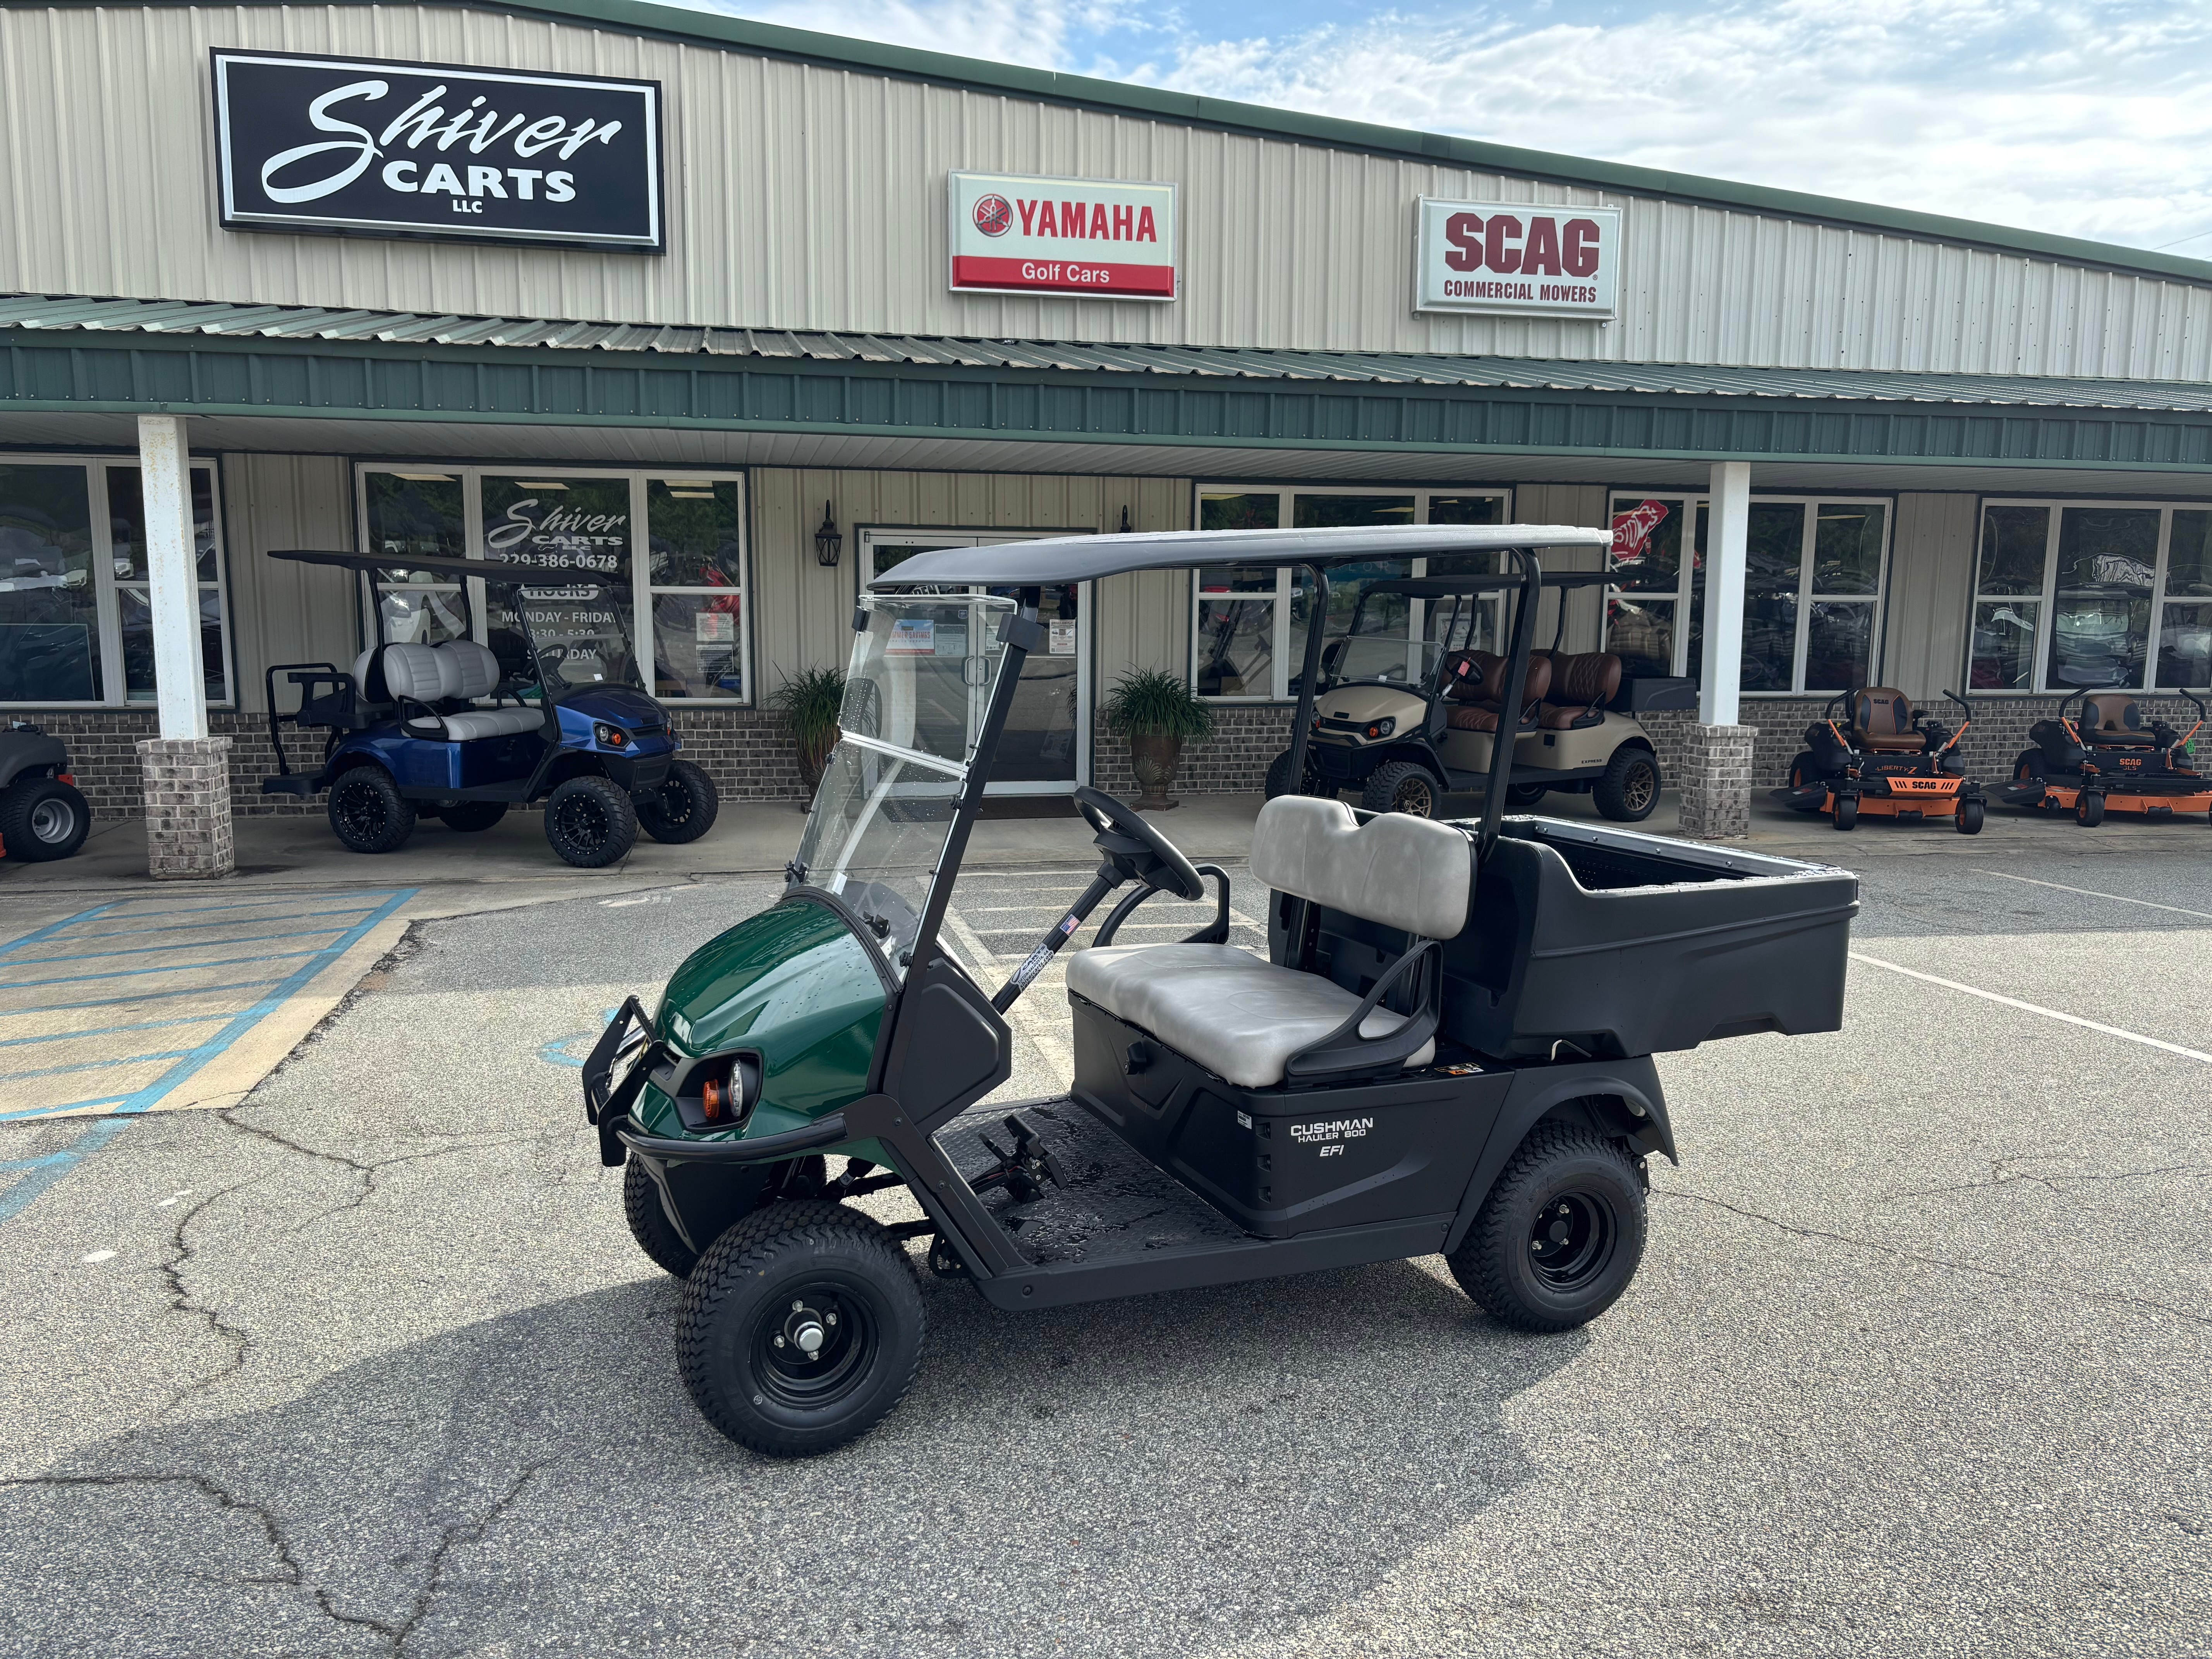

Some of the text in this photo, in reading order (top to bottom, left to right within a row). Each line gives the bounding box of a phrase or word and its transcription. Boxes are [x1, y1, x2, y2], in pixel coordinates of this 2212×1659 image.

[262, 80, 622, 203] Shiver
[382, 160, 576, 203] CARTS
[452, 199, 483, 214] LLC
[1016, 199, 1157, 243] YAMAHA
[1445, 212, 1600, 278] SCAG
[1022, 262, 1110, 283] Golf Cars
[1444, 280, 1597, 303] COMMERCIAL MOWERS
[488, 498, 626, 549] Shiver
[532, 535, 623, 546] CARTS
[500, 554, 618, 568] 229-386-0678
[572, 612, 616, 623] FRIDAY
[527, 649, 597, 659] SUDAY
[1912, 781, 1936, 789] SCAG
[1022, 945, 1046, 971] CARTS
[1290, 1117, 1373, 1136] CUSHMAN
[1298, 1129, 1366, 1143] HAULER 800
[1319, 1145, 1345, 1157] EFI
